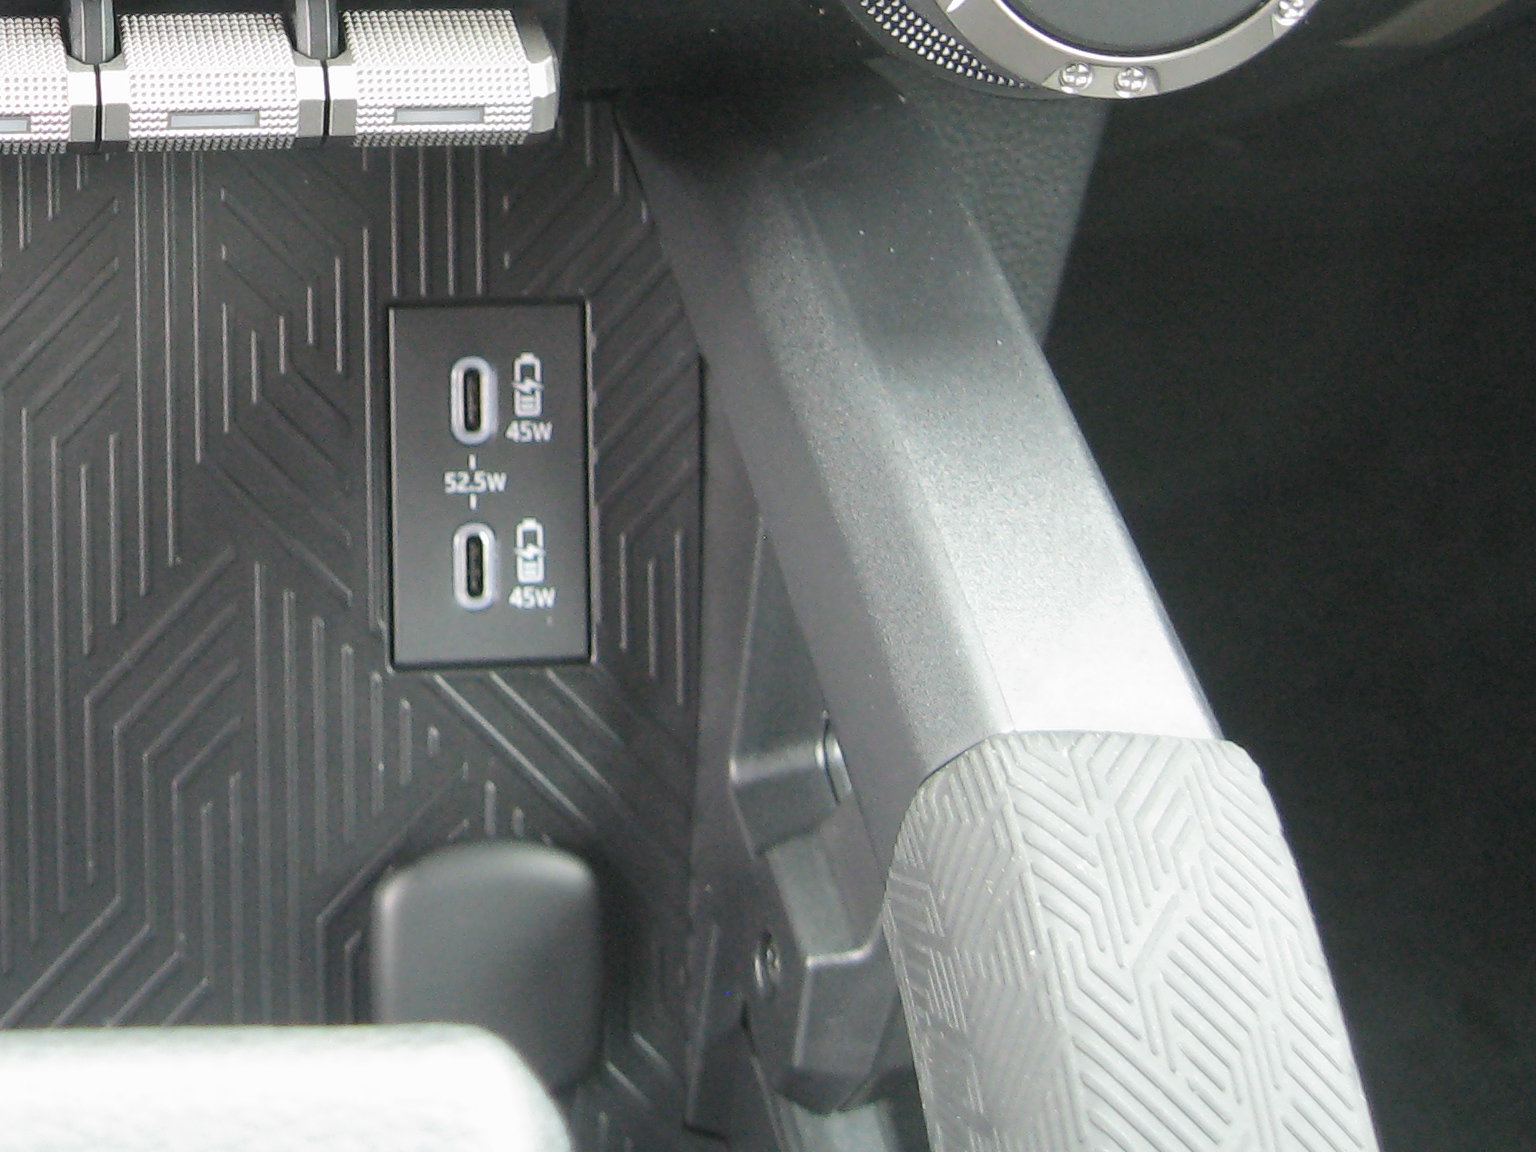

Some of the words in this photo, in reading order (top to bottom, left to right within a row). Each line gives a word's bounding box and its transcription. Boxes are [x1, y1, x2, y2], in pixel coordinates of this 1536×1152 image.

[504, 420, 554, 444] 45W
[443, 471, 508, 494] 52.5W
[508, 586, 556, 610] 45W
